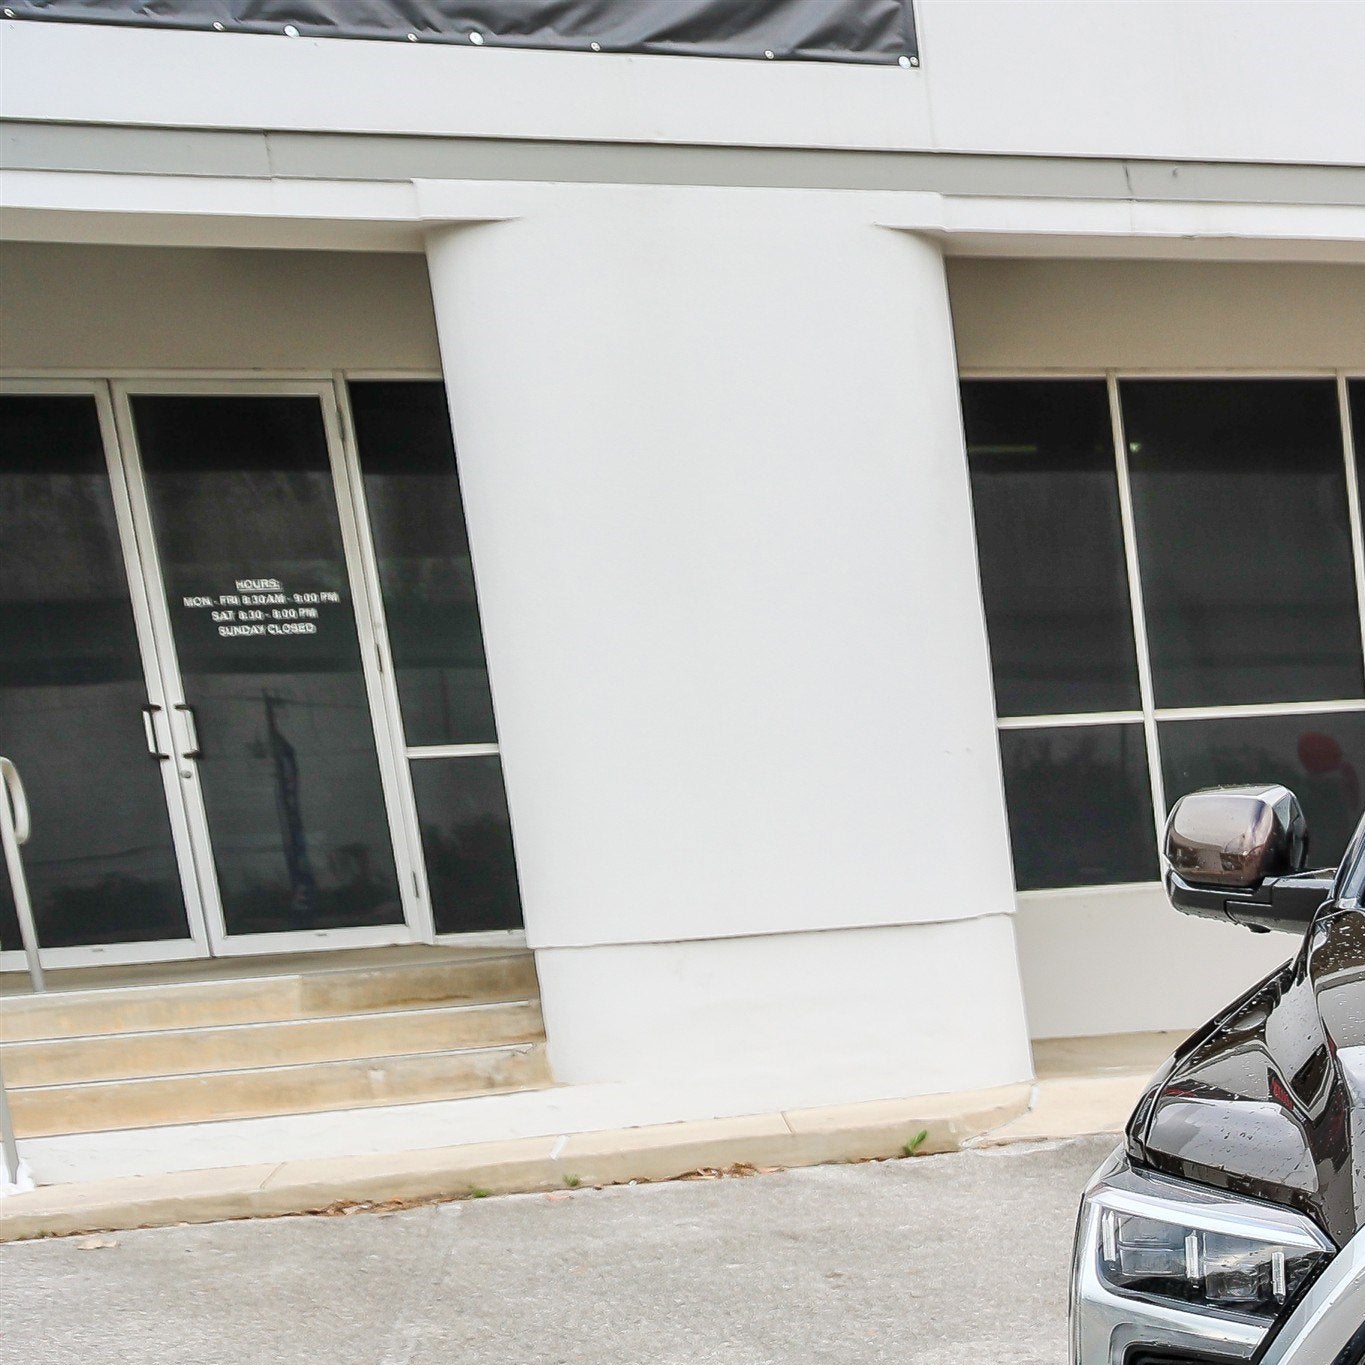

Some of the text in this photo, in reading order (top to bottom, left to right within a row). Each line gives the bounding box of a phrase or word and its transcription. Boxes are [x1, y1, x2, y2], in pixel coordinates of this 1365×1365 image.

[183, 596, 213, 608] MON
[219, 595, 241, 606] FRI
[320, 591, 341, 603] PM
[211, 611, 236, 622] SAT
[298, 607, 319, 619] PM
[218, 622, 318, 637] SUNDAY CLOSED
